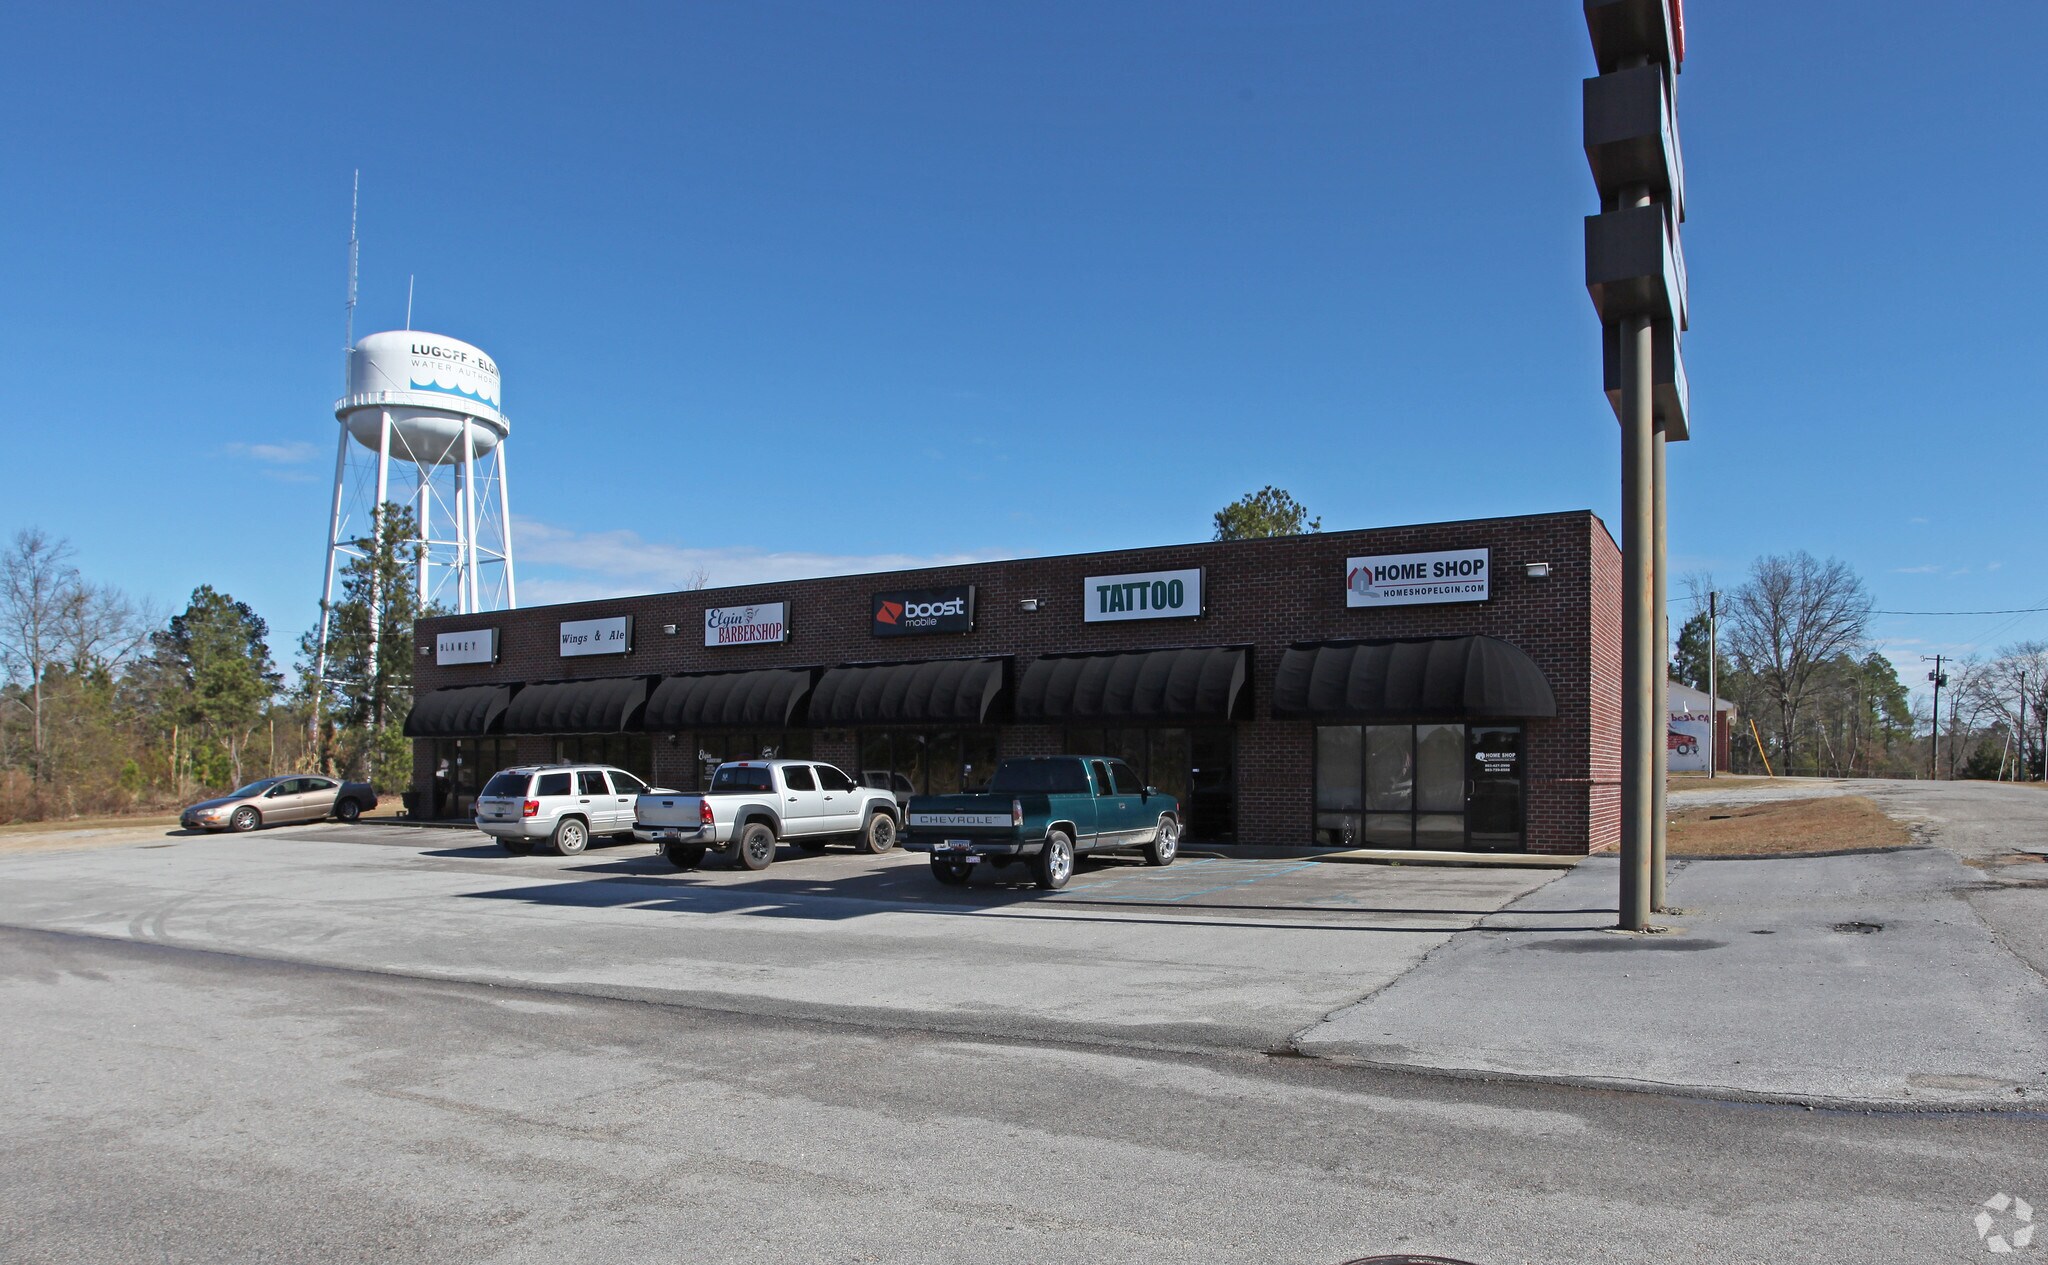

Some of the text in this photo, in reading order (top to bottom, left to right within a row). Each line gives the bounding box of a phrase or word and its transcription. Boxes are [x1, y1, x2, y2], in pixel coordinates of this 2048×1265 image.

[411, 343, 467, 362] LUGOFF
[411, 359, 452, 372] WATER
[1374, 559, 1485, 582] HOME SHOP
[1096, 578, 1184, 614] TATTOO
[1383, 584, 1485, 598] HOMESHOPELGIN.COM
[905, 596, 965, 619] boost
[707, 607, 744, 629] Elgin
[905, 618, 938, 628] mobile
[562, 629, 626, 646] Wings & Ale
[718, 622, 783, 644] BARBERSHOP
